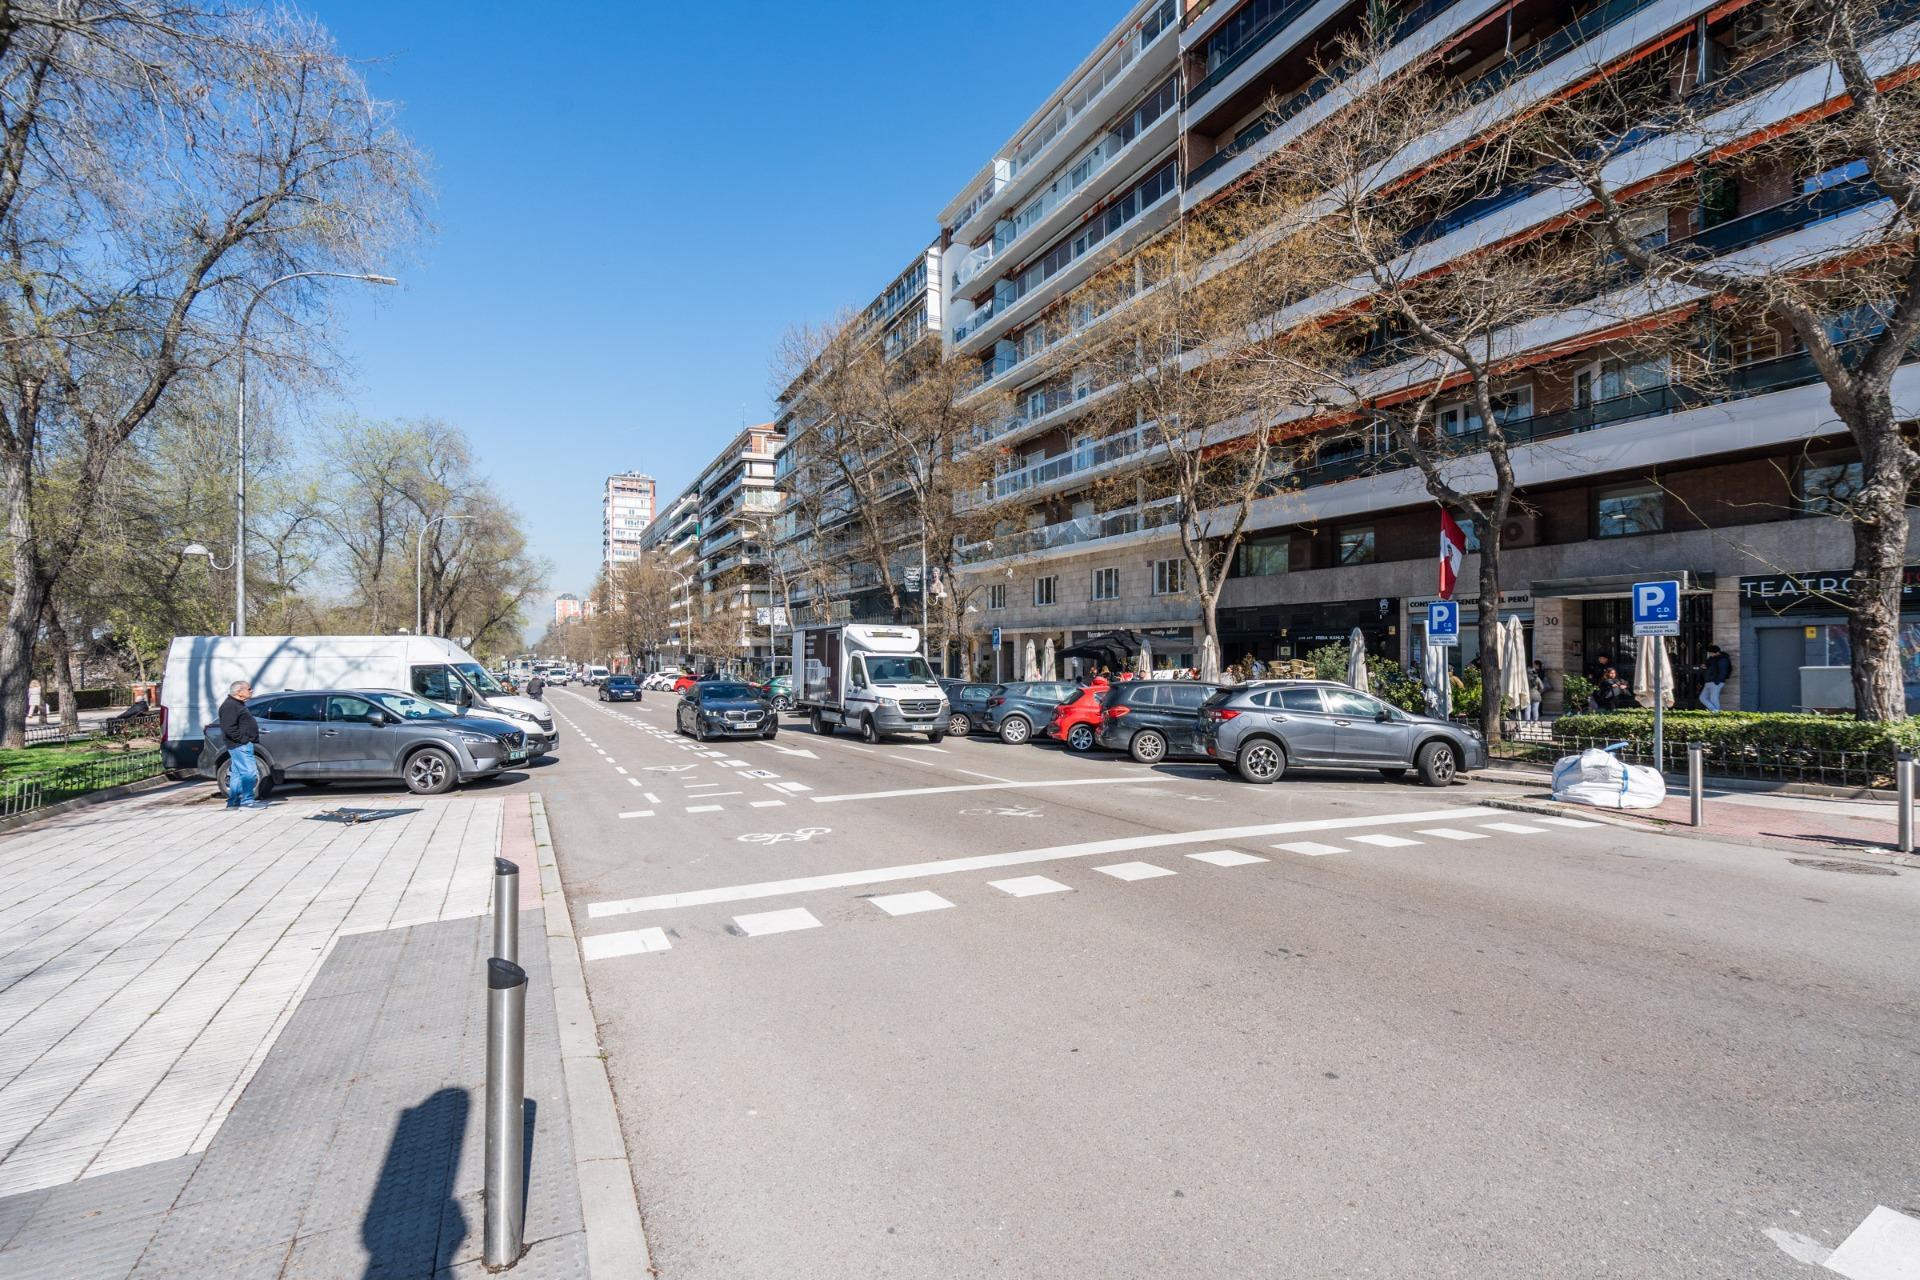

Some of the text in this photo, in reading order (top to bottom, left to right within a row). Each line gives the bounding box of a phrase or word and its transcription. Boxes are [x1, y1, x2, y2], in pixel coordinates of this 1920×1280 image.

[1639, 586, 1665, 616] P
[1432, 605, 1449, 630] P
[1545, 616, 1558, 625] 30
